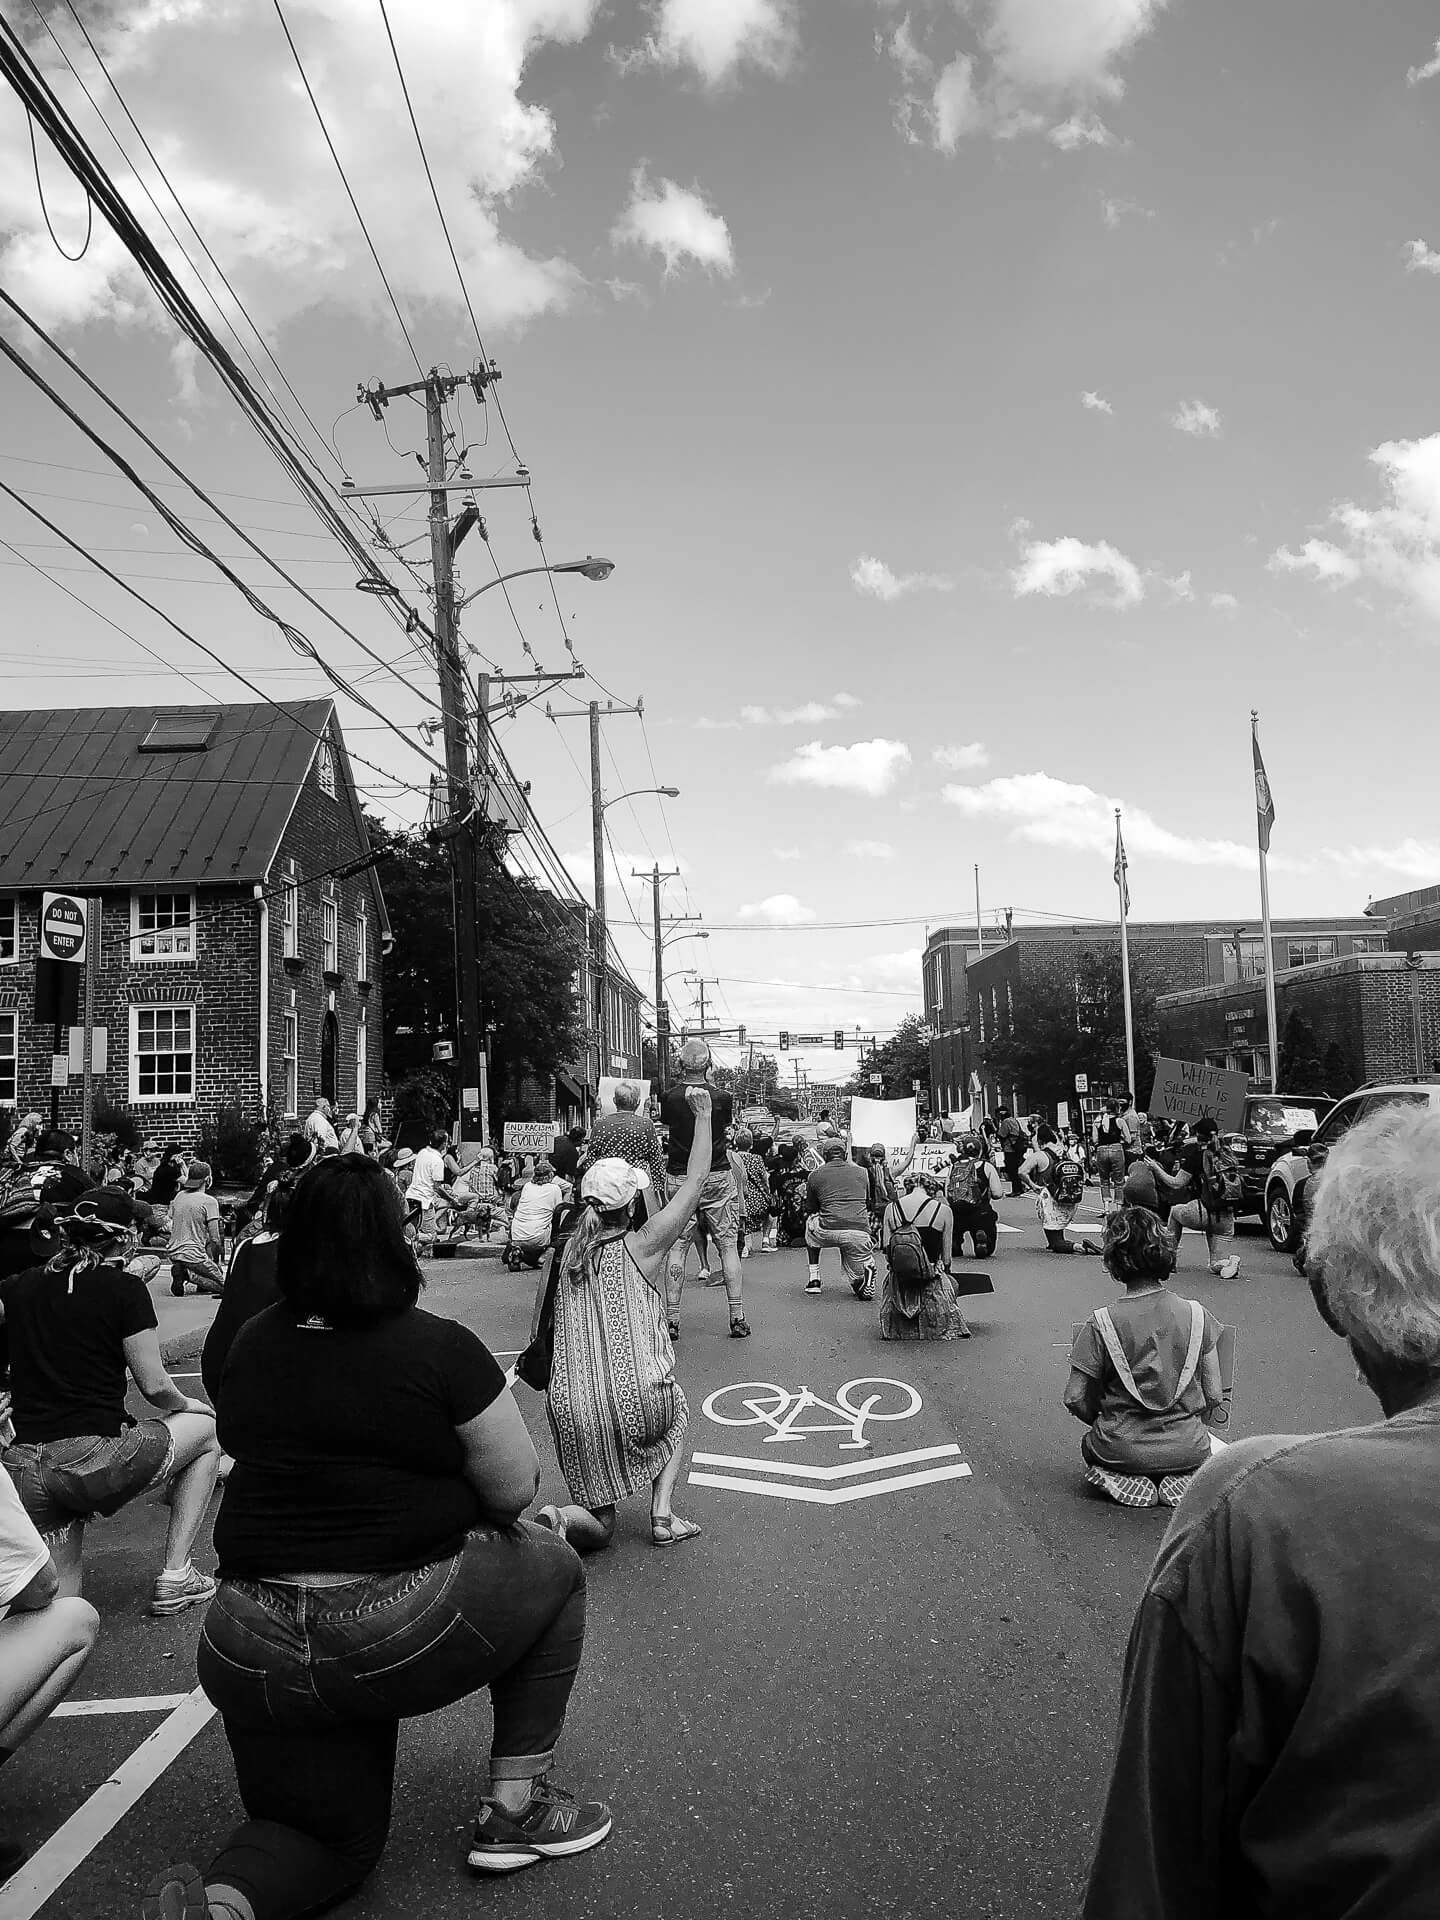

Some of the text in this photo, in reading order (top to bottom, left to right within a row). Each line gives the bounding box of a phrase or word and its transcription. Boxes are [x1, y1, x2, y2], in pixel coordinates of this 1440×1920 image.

[52, 908, 78, 921] DO NOT
[53, 935, 75, 948] ENTER
[1181, 1063, 1225, 1087] WHITE
[1163, 1080, 1230, 1103] SILENCE IS
[1164, 1095, 1226, 1121] VIOLENCE
[505, 1123, 522, 1131] END
[510, 1133, 548, 1148] EVOLVE!
[892, 1156, 945, 1172] MTTER
[549, 1810, 573, 1833] N
